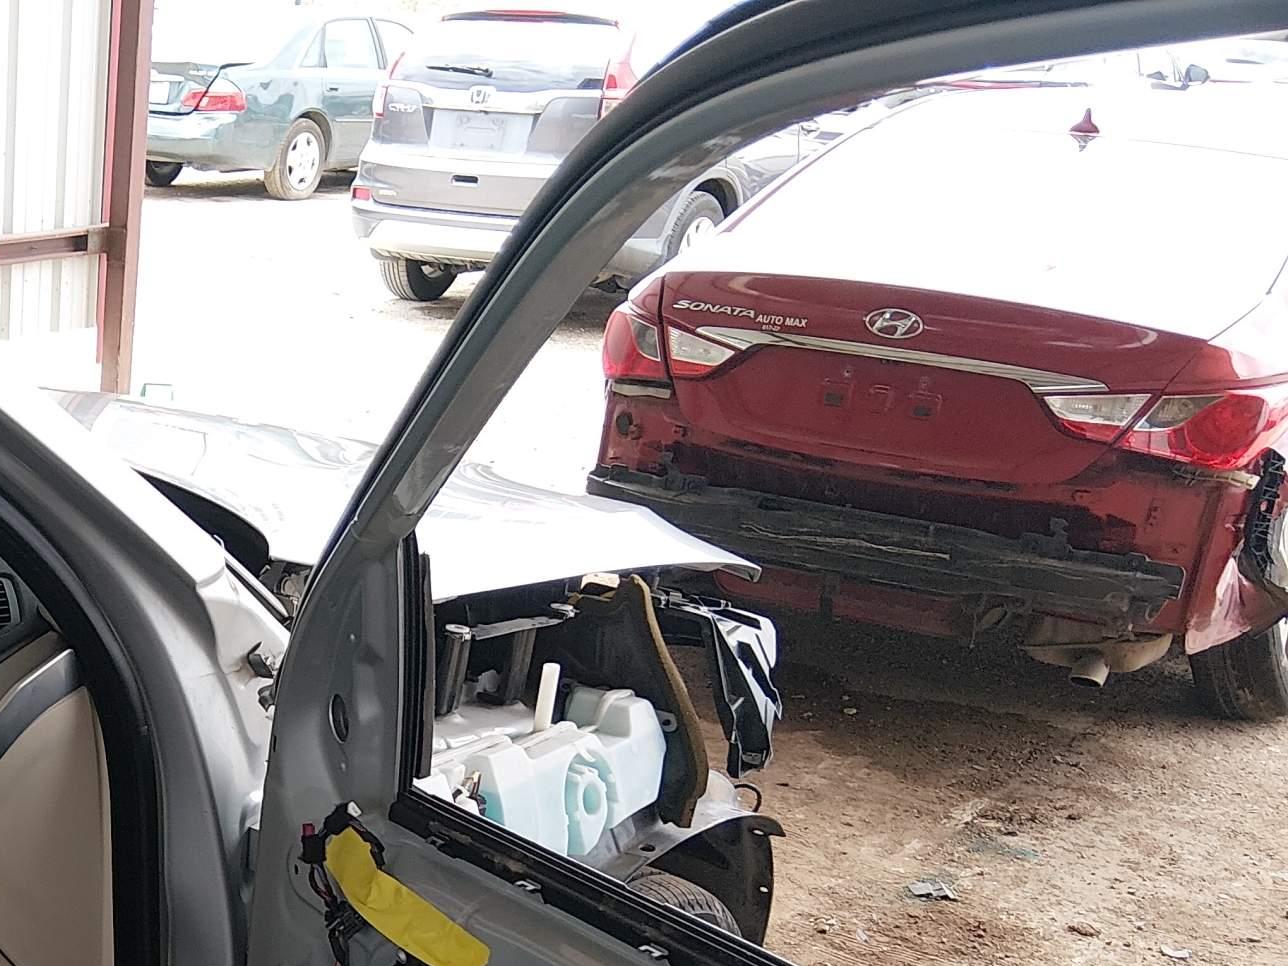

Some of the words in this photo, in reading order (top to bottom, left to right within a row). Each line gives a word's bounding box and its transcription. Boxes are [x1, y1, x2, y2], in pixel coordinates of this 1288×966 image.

[672, 299, 755, 319] SONATA
[755, 314, 784, 325] AUTO
[784, 317, 808, 328] MAX
